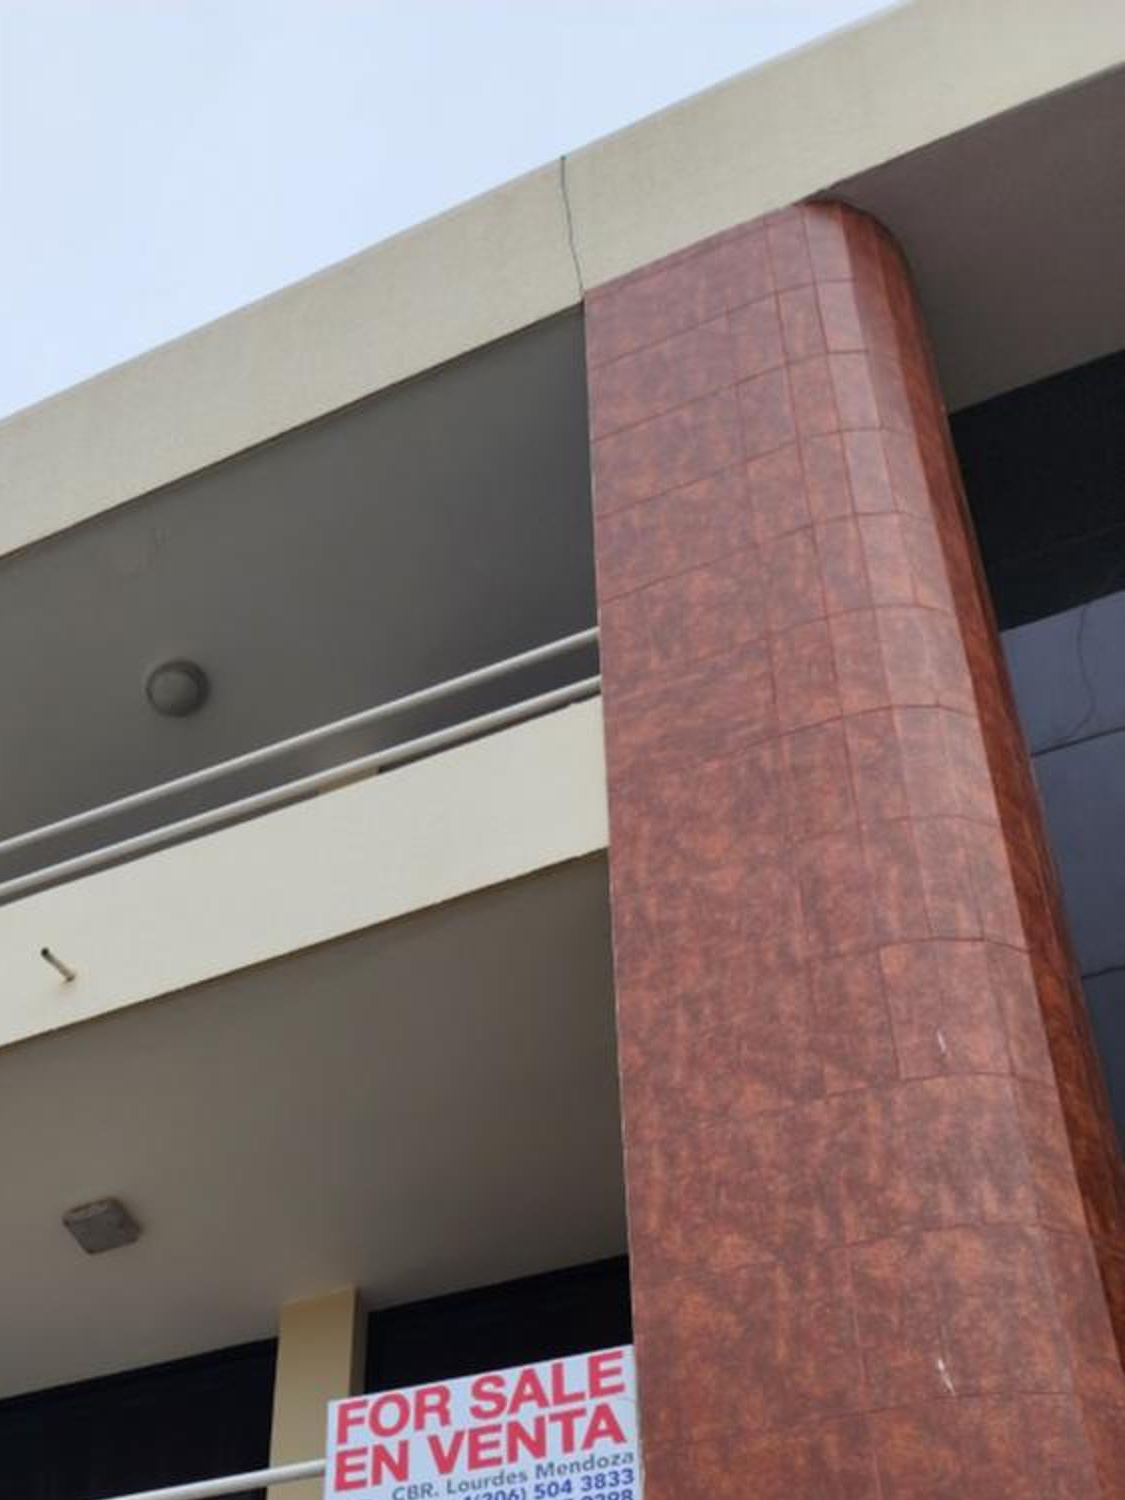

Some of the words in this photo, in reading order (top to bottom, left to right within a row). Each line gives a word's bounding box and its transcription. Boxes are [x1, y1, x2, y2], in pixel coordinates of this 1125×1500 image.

[335, 1384, 452, 1446] FOR
[469, 1350, 626, 1421] SALE
[333, 1440, 410, 1493] EN
[429, 1402, 627, 1476] VENTA
[446, 1471, 528, 1496] Lourdes
[535, 1452, 635, 1479] Mendoza
[534, 1480, 573, 1500] 504
[581, 1468, 635, 1492] 3833
